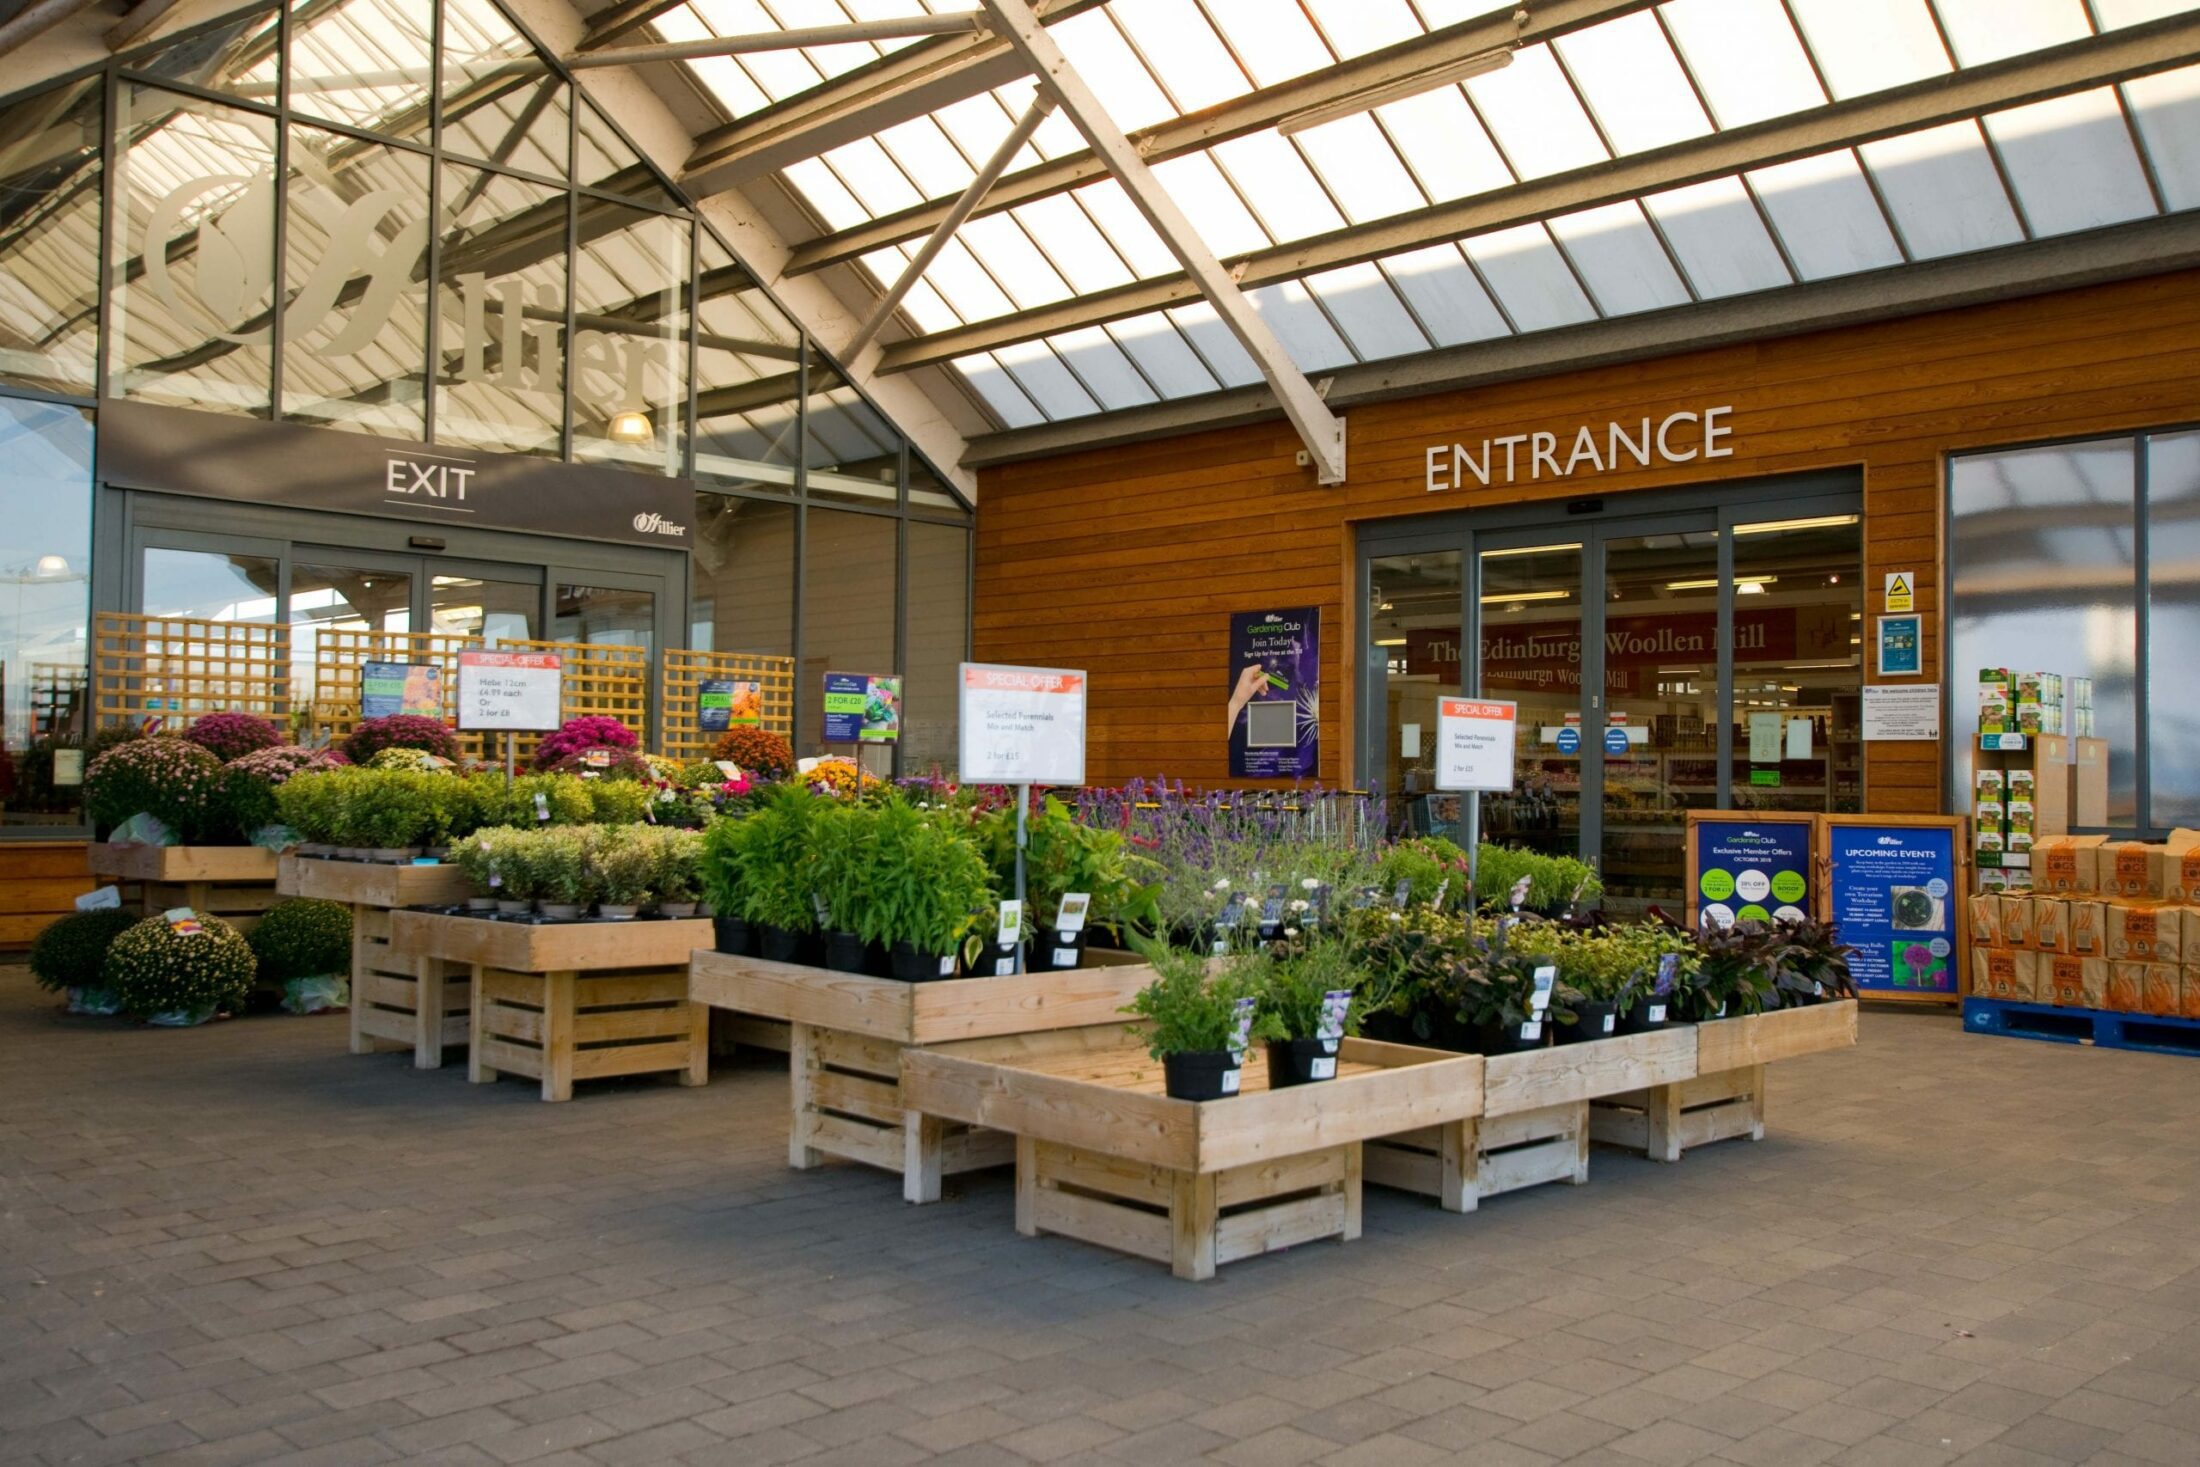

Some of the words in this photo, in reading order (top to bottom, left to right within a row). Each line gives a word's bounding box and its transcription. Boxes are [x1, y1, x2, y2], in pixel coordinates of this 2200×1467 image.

[143, 164, 668, 405] Hllier
[1425, 405, 1734, 492] ENTRANCE
[386, 459, 476, 501] EXIT
[633, 511, 686, 537] Hillier
[1247, 624, 1283, 634] Gardening
[1283, 621, 1301, 631] Club
[1252, 637, 1267, 649] Join
[1268, 635, 1295, 648] Today!
[1427, 640, 1462, 662] Th
[1479, 635, 1581, 663] Edinburg
[1604, 628, 1705, 655] Woollen
[479, 653, 514, 664] SPECIAL
[518, 655, 545, 666] OFFER
[1244, 650, 1254, 659] Sign
[480, 678, 501, 687] Hebe
[504, 679, 527, 687] 12cm
[986, 672, 1028, 687] SPECIAL
[1031, 674, 1064, 688] OFFER
[1605, 670, 1628, 689] Mill
[503, 689, 522, 697] each
[480, 698, 492, 707] Or
[827, 696, 832, 704] 2
[834, 696, 848, 704] FOR
[479, 708, 485, 716] 2
[486, 708, 498, 717] for
[1454, 703, 1481, 715] SPECIAL
[1482, 705, 1503, 716] OFFER
[986, 710, 1017, 720] Selected
[987, 721, 999, 730] Mix
[1000, 722, 1013, 731] and
[1014, 723, 1035, 732] Match
[1454, 732, 1473, 741] Selected
[986, 751, 992, 760] 2
[993, 751, 1004, 760] for
[1005, 752, 1020, 761] £15
[1726, 836, 1761, 845] Gardening
[1771, 848, 1793, 856] Offers
[1845, 849, 1898, 857] UPCOMING
[1899, 850, 1937, 859] EVENTS
[2048, 854, 2075, 862] COFFEE
[2117, 855, 2146, 863] COFFEE
[1850, 897, 1878, 905] Workshop
[2054, 961, 2081, 969] COFFEE
